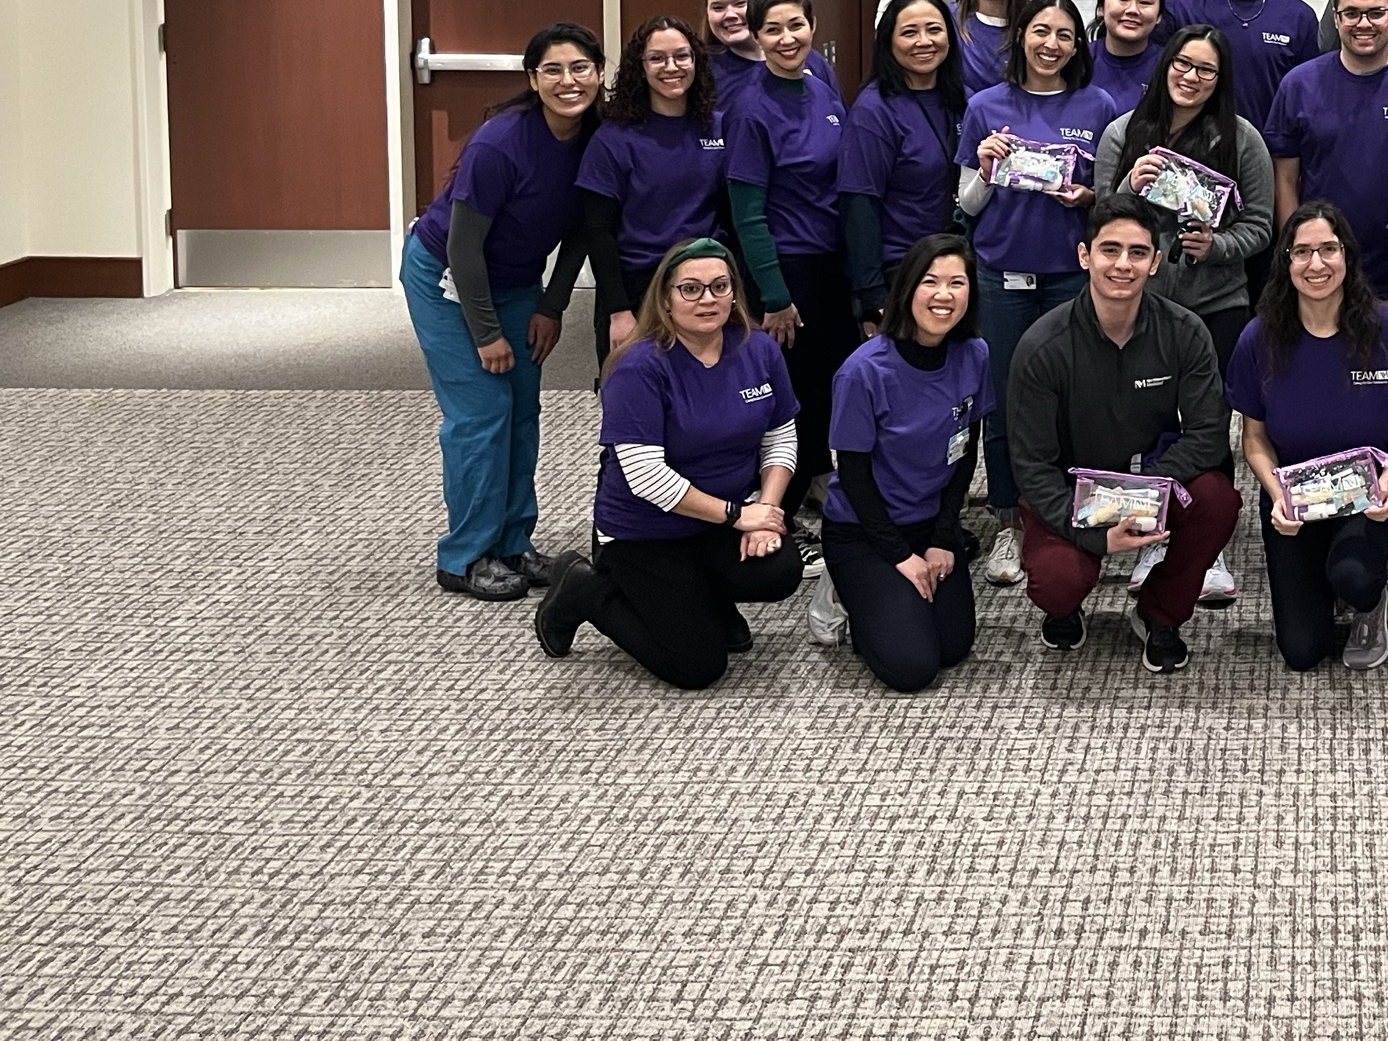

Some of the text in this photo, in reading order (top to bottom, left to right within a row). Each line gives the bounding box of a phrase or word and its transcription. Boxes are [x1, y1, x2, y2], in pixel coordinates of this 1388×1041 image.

[1059, 127, 1084, 138] TEAM
[699, 138, 720, 147] TEAM
[1350, 370, 1377, 381] TEAM
[739, 386, 765, 400] TEAM
